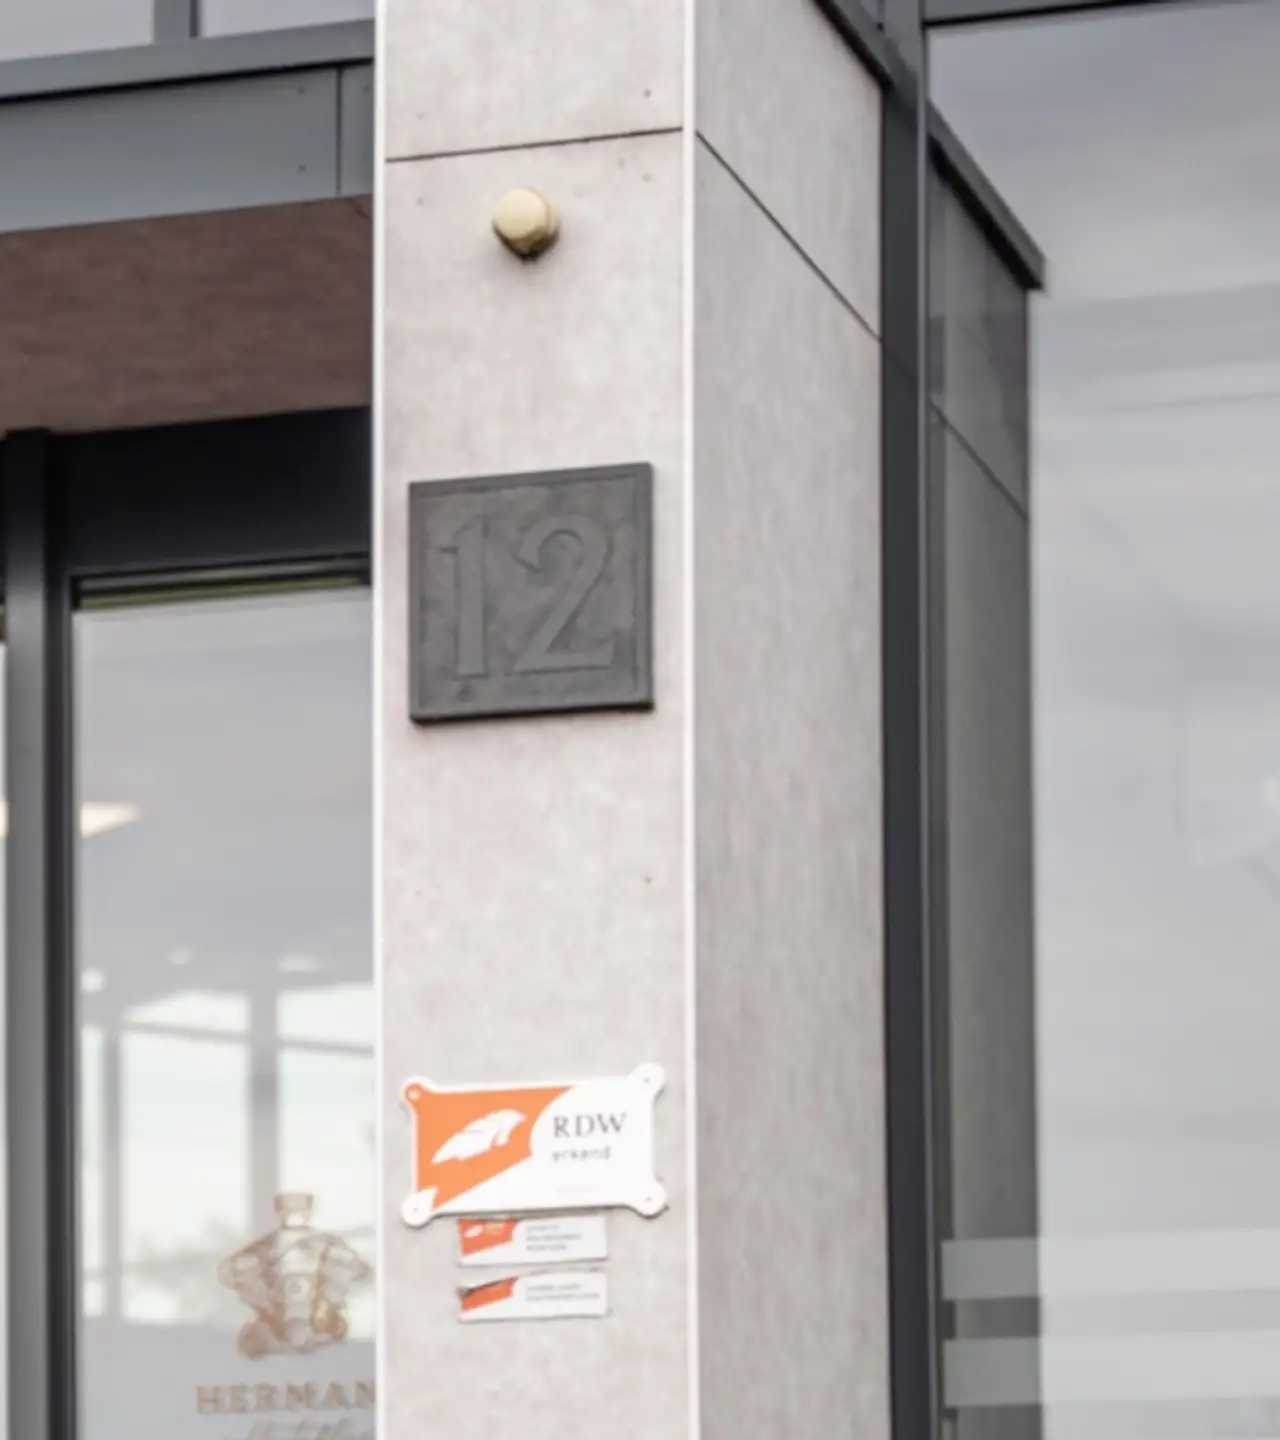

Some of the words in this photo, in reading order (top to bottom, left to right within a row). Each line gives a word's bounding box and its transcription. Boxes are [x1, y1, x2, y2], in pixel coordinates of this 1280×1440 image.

[440, 513, 615, 680] 12
[552, 1111, 628, 1138] RDW
[196, 1380, 377, 1415] HERMAN
